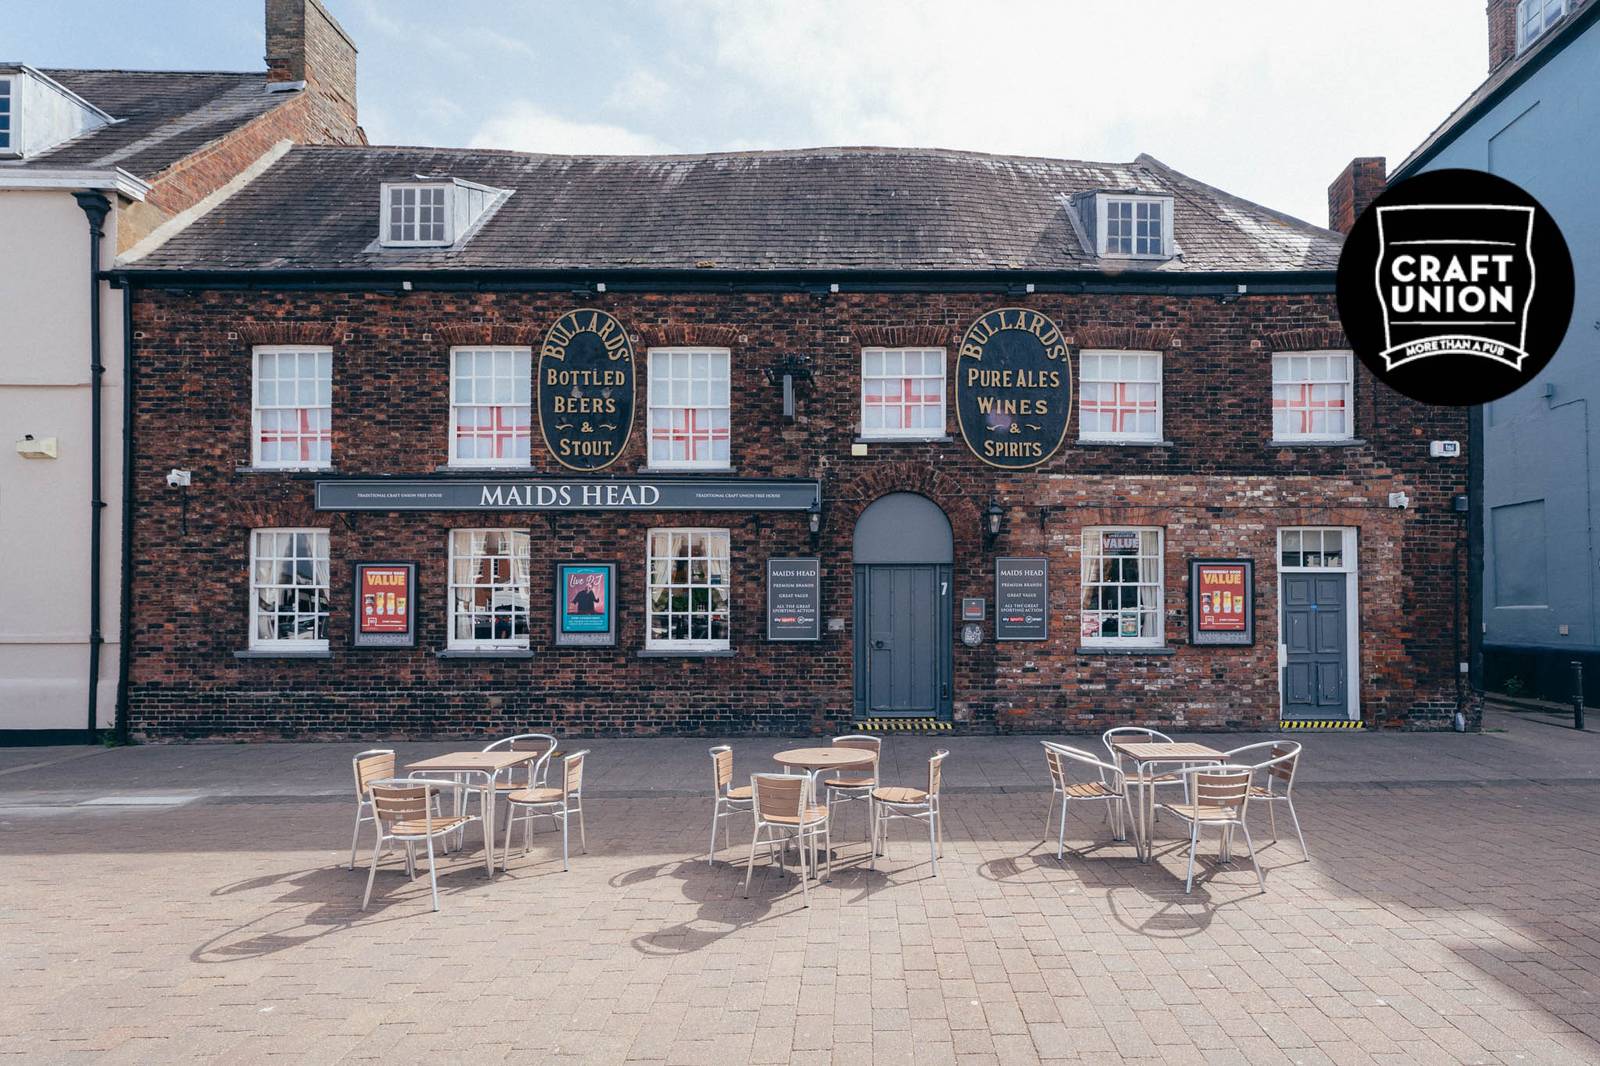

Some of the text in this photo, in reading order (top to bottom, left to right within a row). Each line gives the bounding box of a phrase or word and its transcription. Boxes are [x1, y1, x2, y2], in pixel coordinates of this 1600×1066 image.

[547, 368, 625, 386] BOTTLED
[968, 368, 1060, 388] PURE ALES
[554, 396, 616, 413] BEERS
[977, 396, 1048, 415] WINES
[581, 422, 594, 433] &
[1009, 423, 1021, 434] &
[984, 440, 1043, 457] SPIRITS
[479, 485, 660, 506] MAIDS HEAD
[1103, 538, 1139, 549] VALUE
[367, 575, 405, 586] VALUE
[569, 574, 584, 588] Live
[1204, 574, 1241, 585] VALUE
[941, 582, 948, 596] 7
